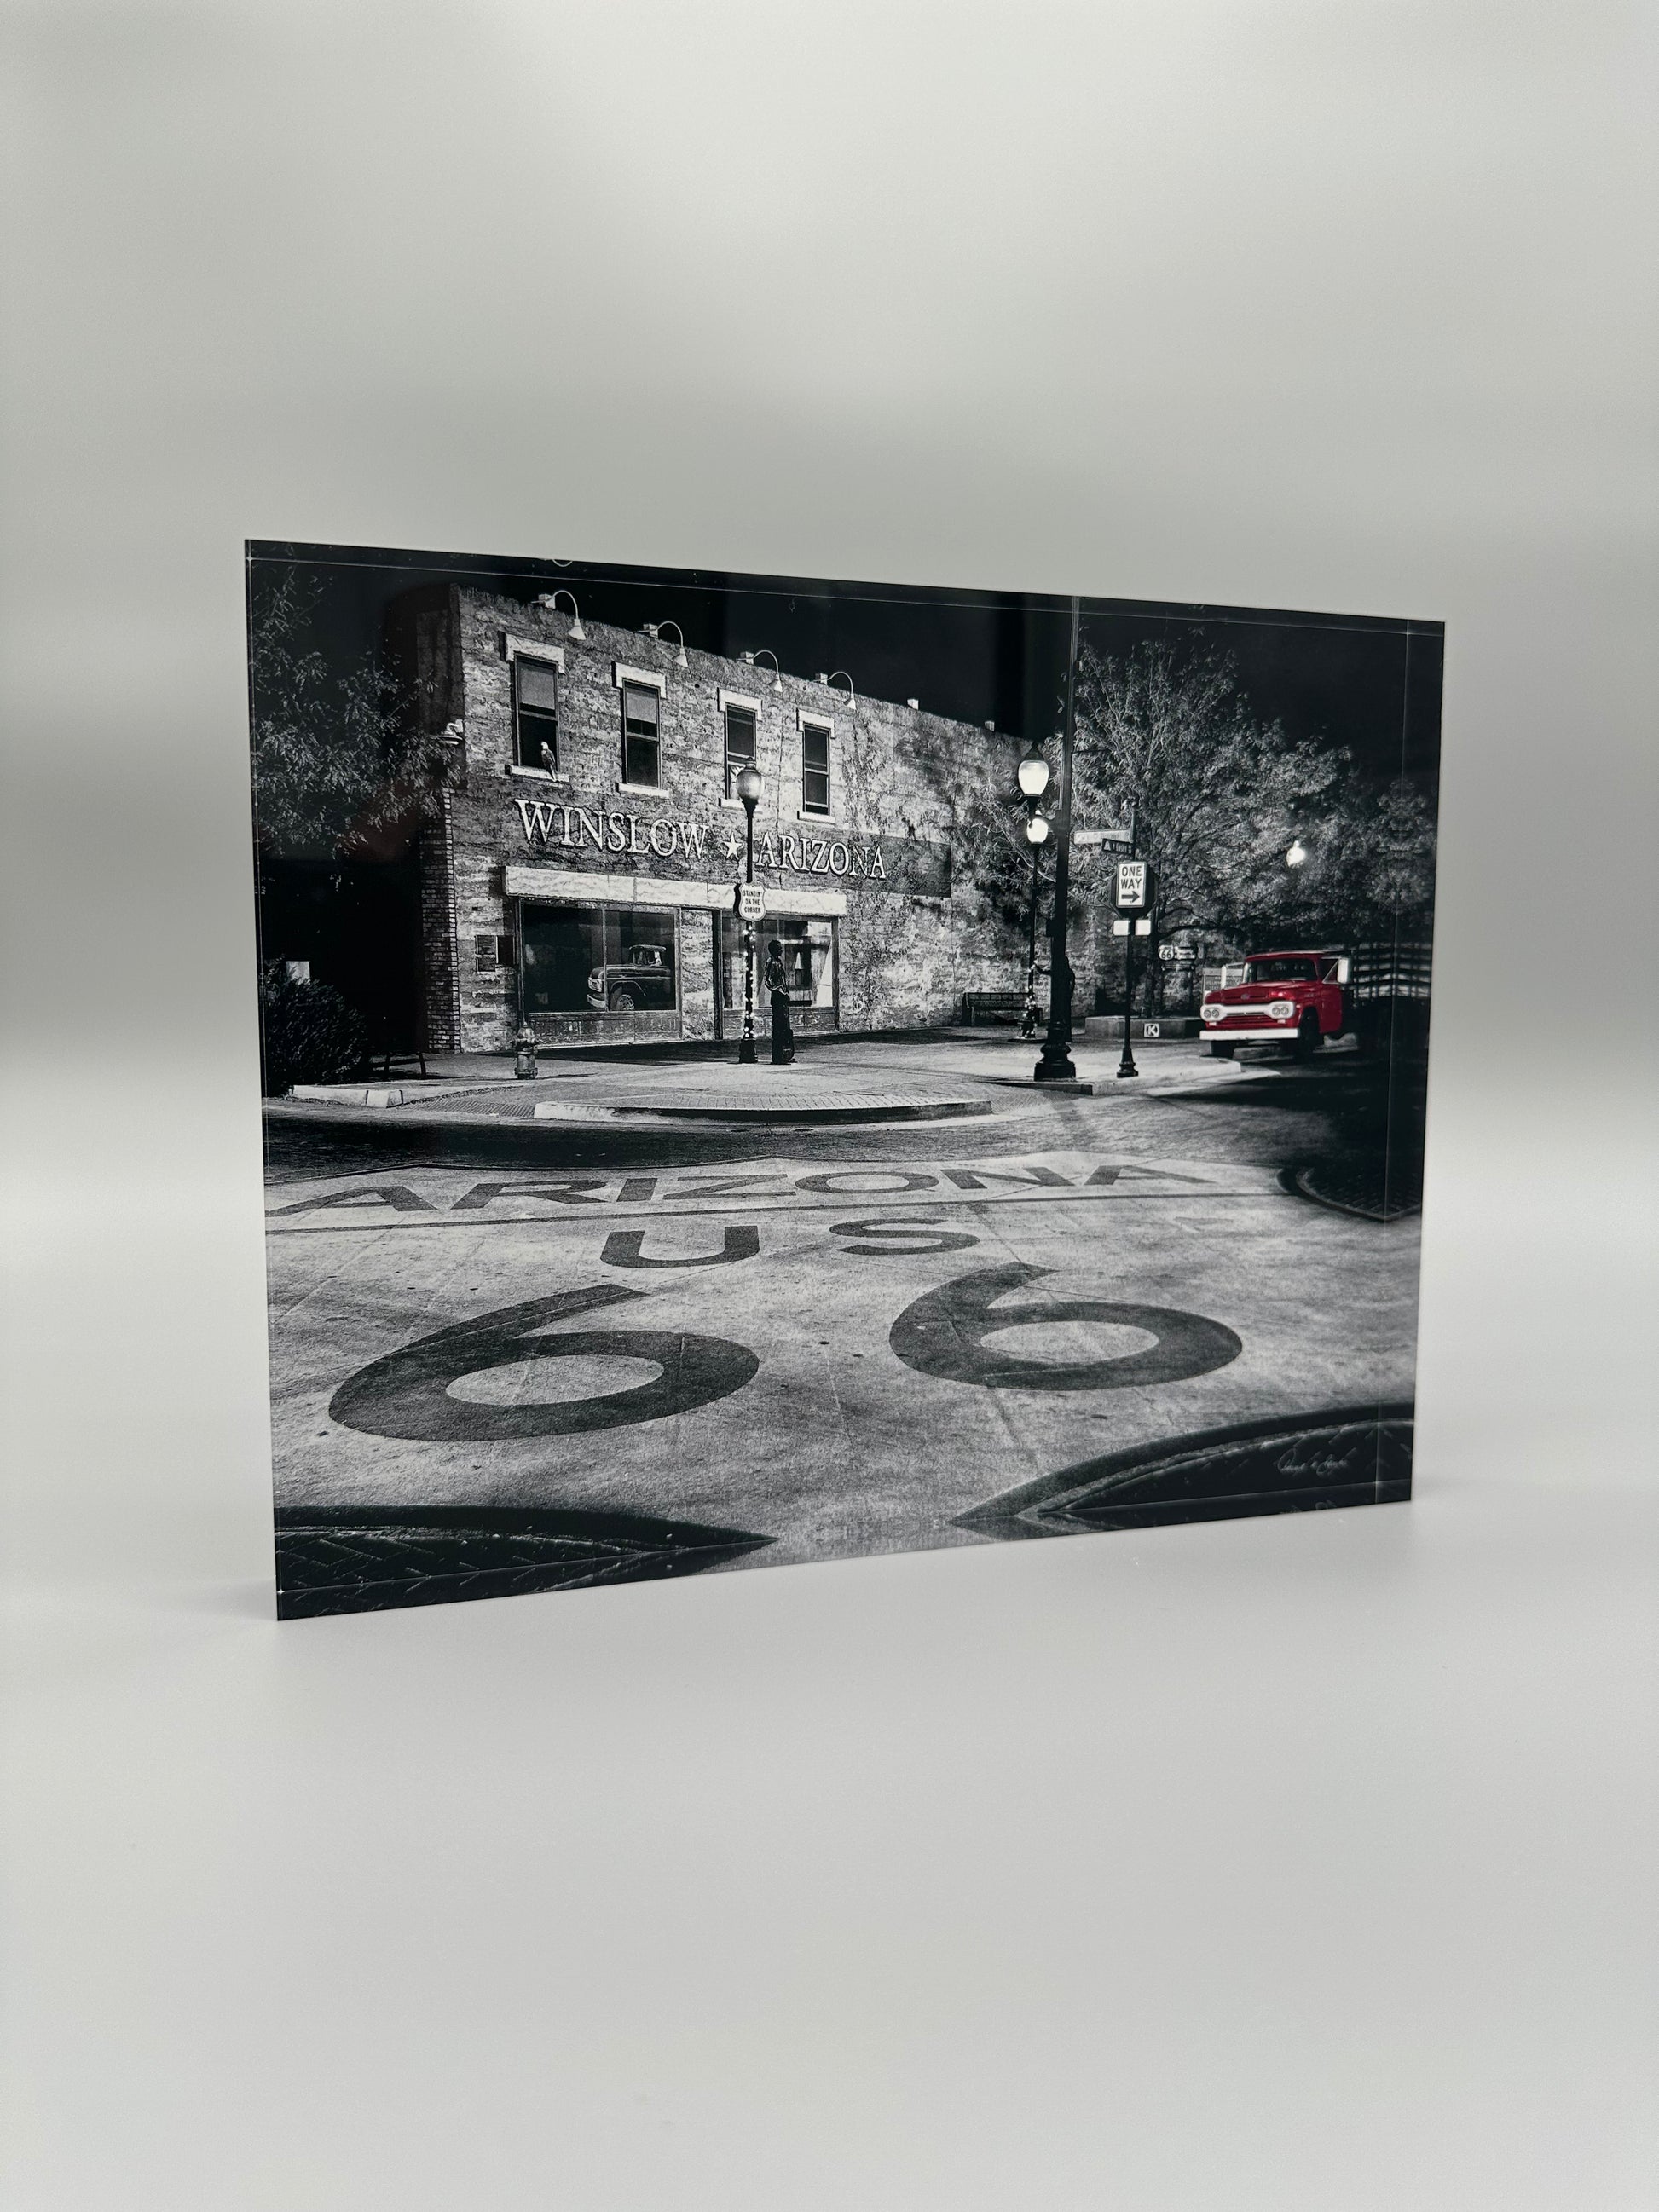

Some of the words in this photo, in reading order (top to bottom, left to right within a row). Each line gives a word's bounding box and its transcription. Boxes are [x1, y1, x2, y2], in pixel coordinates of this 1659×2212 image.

[514, 798, 709, 859] WINSLOW
[757, 832, 887, 880] ARIZONA
[1122, 865, 1142, 877] ONE
[1120, 878, 1142, 889] WAY
[1160, 950, 1173, 960] 66
[1147, 1025, 1158, 1037] K
[265, 1164, 1217, 1217] ARIZONA
